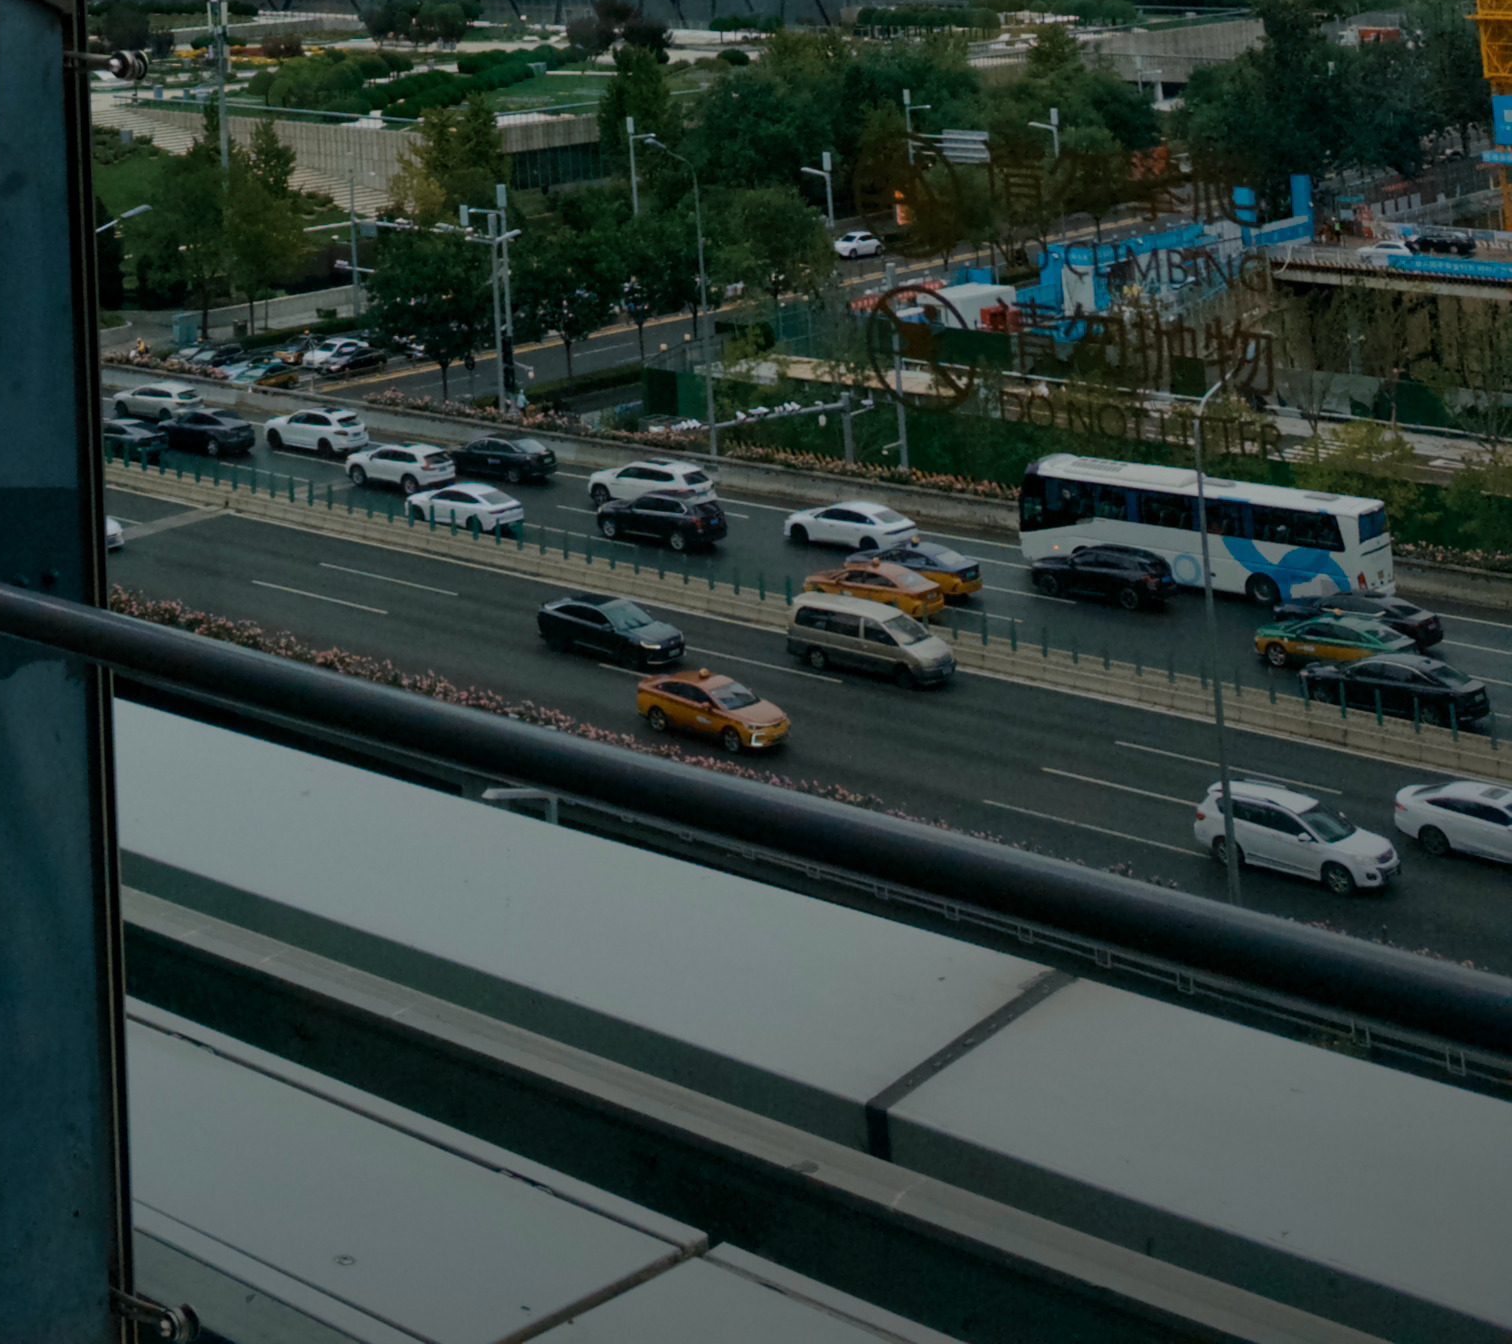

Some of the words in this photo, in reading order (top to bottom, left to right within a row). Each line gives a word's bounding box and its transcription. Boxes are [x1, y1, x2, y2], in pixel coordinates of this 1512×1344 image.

[1064, 239, 1270, 293] CLIMBING
[999, 389, 1056, 428] DO
[1068, 396, 1146, 441] NOT
[1157, 407, 1284, 464] LITTER
